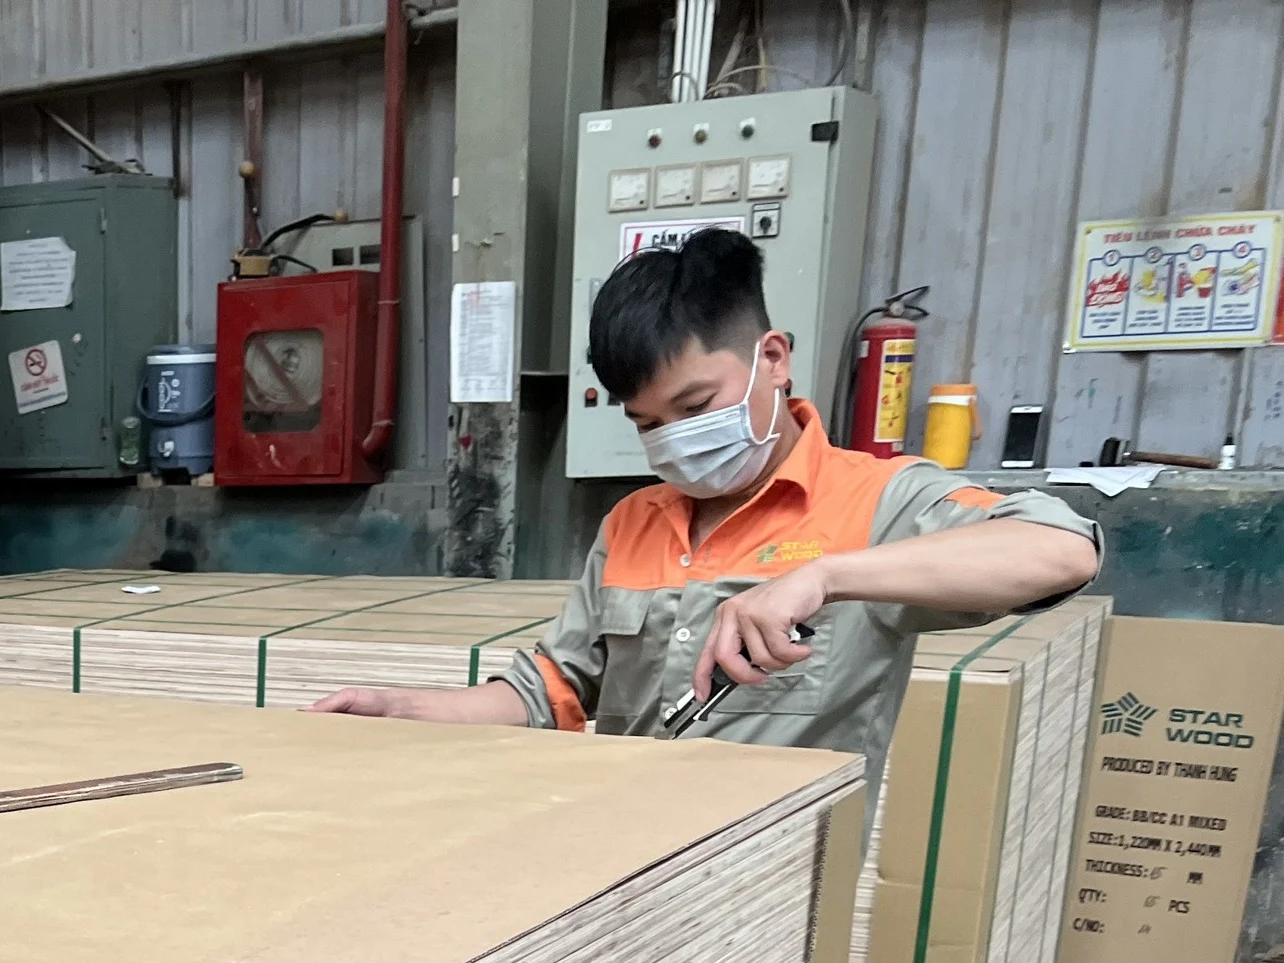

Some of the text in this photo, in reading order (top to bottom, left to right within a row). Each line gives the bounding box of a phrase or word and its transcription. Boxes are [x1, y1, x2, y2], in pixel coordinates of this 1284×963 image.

[779, 540, 820, 551] STAR
[780, 549, 823, 561] WOOD
[1168, 708, 1243, 728] STAR
[1165, 727, 1255, 749] WOOD
[1100, 756, 1238, 782] PRODUCED BY THANH HUNG
[1095, 805, 1131, 820] GRADE:
[1187, 815, 1227, 831] MIXED
[1085, 859, 1149, 878] THICKNESS:
[1168, 900, 1191, 914] PCS
